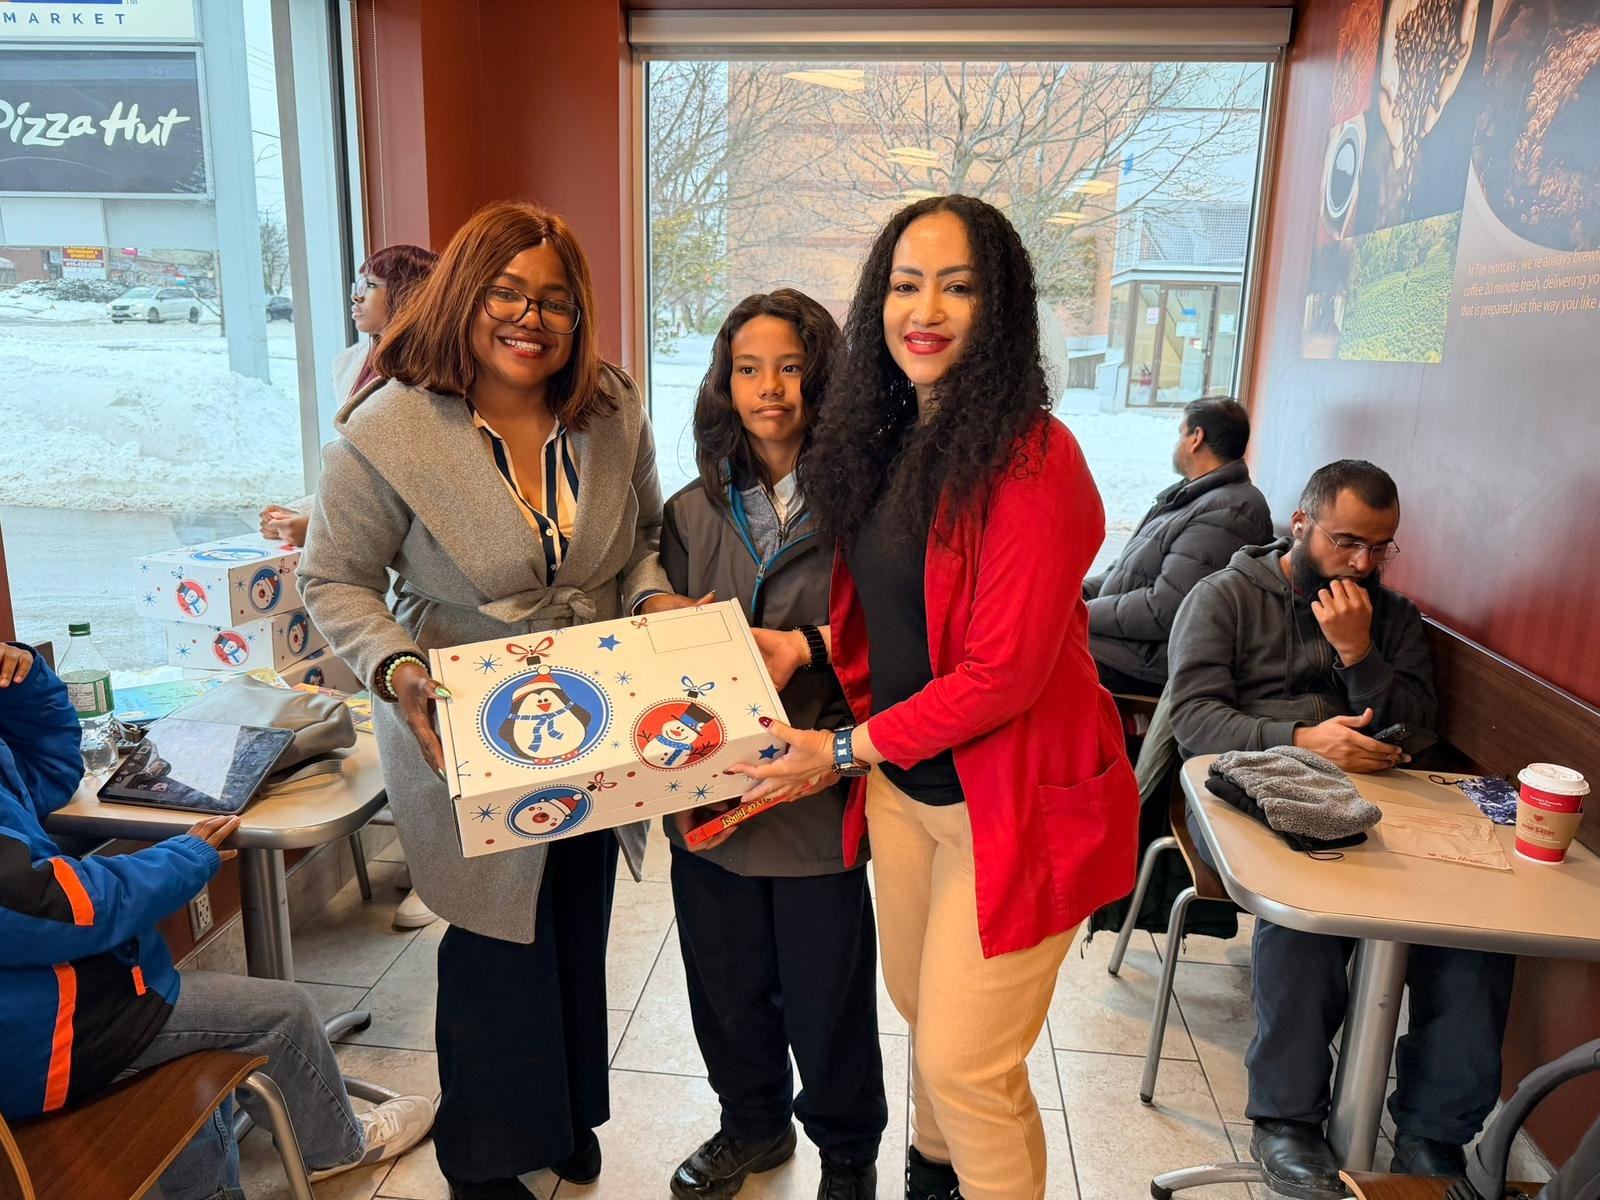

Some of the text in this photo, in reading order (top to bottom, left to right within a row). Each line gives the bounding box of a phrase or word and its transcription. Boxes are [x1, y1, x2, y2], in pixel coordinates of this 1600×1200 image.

[3, 12, 126, 25] MARKET
[99, 101, 191, 146] Hut
[1493, 279, 1520, 294] minute
[1543, 272, 1586, 289] delivering
[1480, 300, 1513, 318] prepared
[1511, 300, 1527, 317] just
[1528, 298, 1542, 313] the
[1543, 299, 1560, 315] way
[1560, 298, 1579, 315] you
[1580, 293, 1597, 309] like
[721, 808, 750, 829] THIRST
